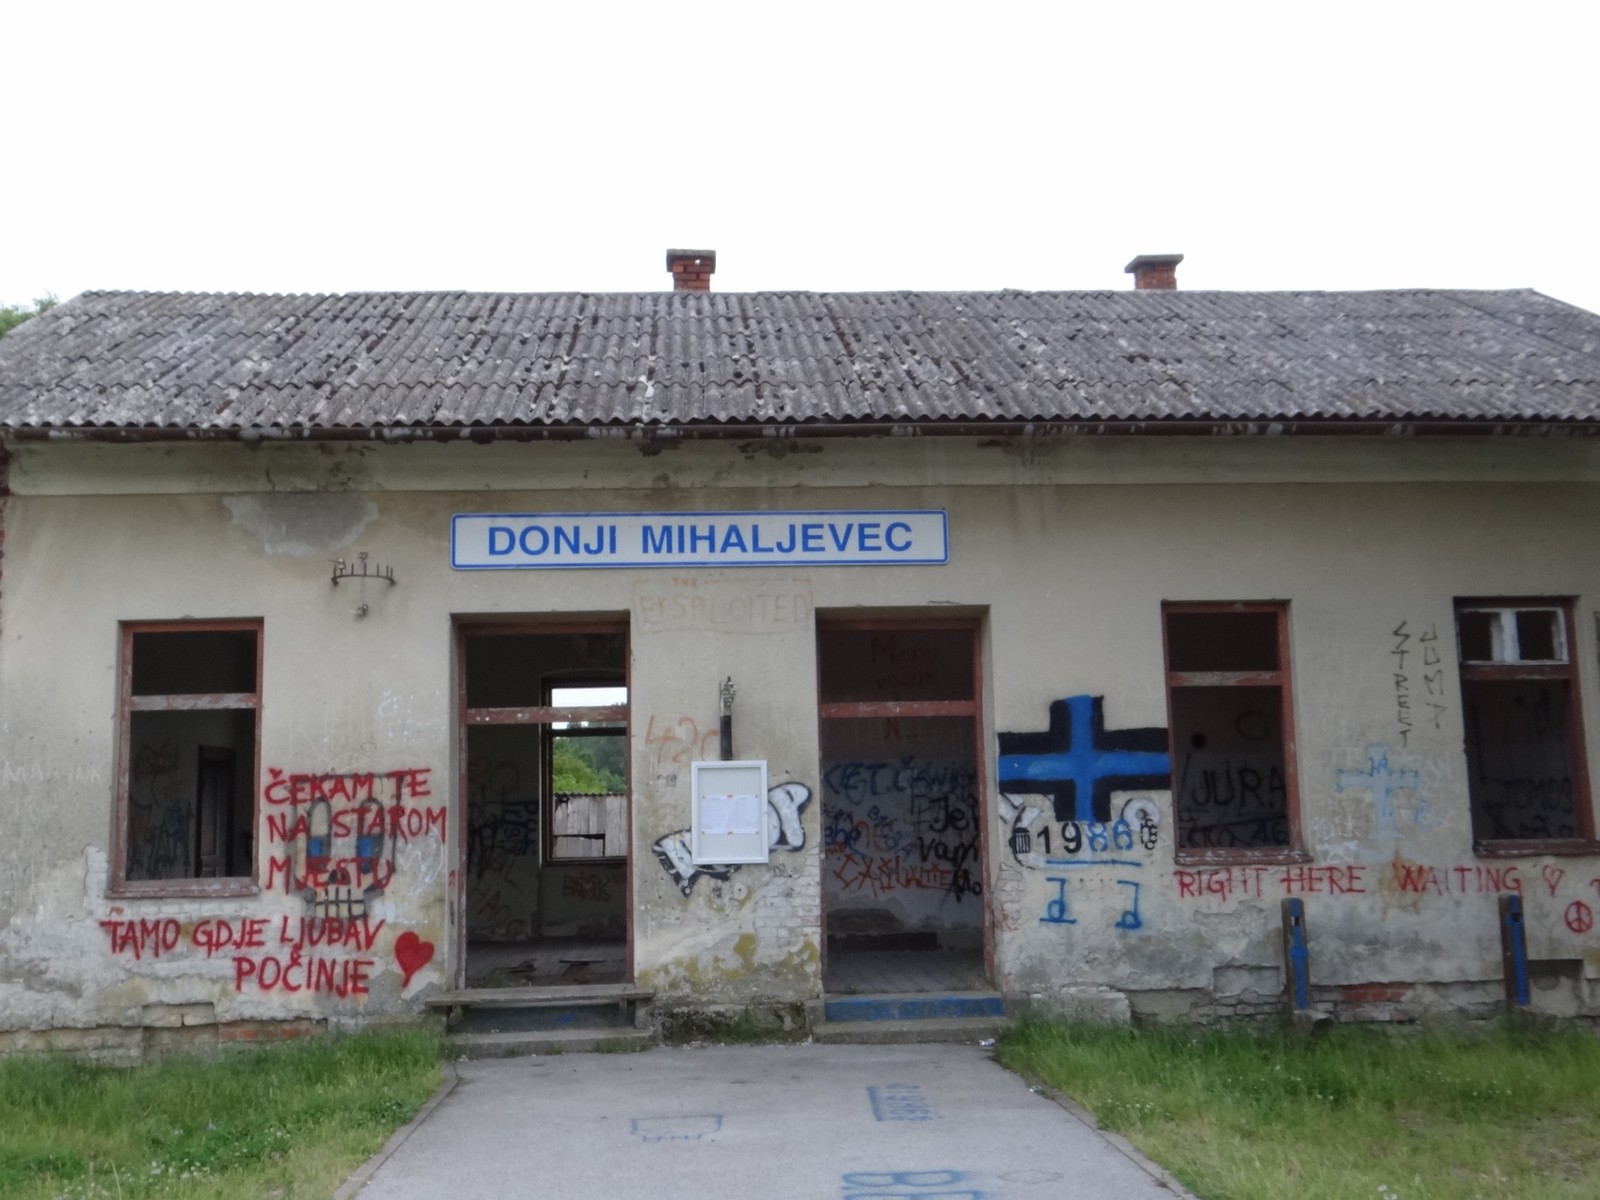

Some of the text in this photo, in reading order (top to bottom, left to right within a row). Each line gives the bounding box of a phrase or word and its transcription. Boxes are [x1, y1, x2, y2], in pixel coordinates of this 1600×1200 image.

[487, 521, 914, 556] DONJI MIHALJEVEC
[264, 767, 432, 807] ČEKAM TE
[266, 811, 310, 844] NA
[331, 805, 448, 844] STAROM
[1036, 818, 1134, 855] 1986
[265, 854, 395, 895] MJESTU
[1173, 863, 1523, 902] RIGHT HERE WAITING
[99, 915, 386, 960] TAMO GDJE LJUBAV
[232, 943, 376, 994] POČINJE
